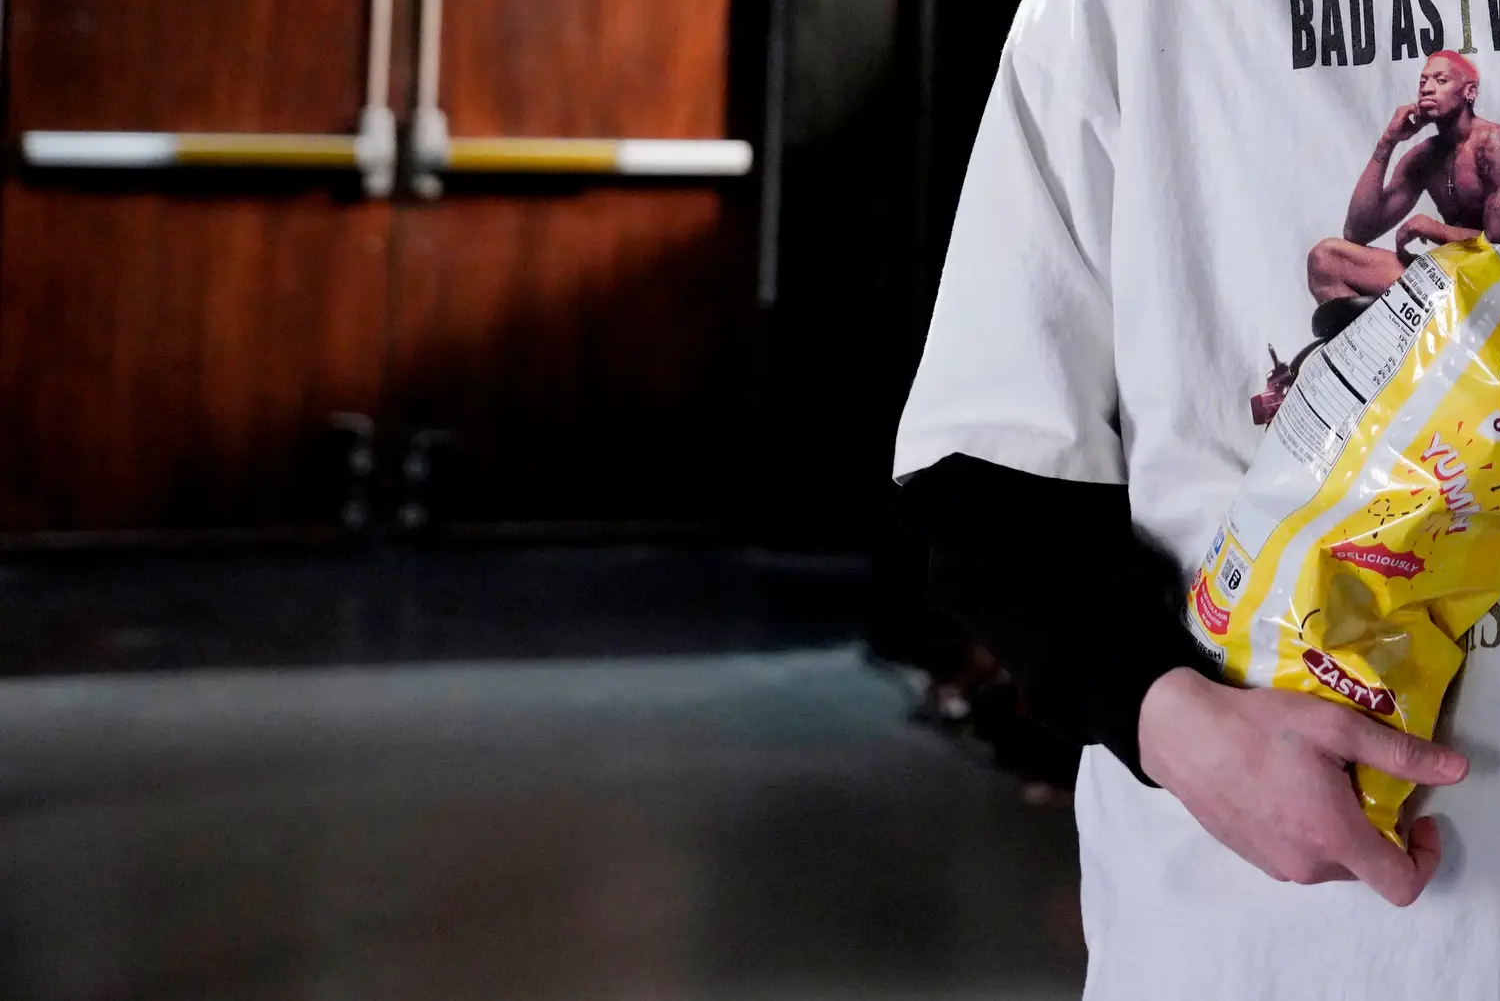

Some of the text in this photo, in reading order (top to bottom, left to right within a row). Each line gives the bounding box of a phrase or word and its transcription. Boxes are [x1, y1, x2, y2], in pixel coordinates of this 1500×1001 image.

[1426, 267, 1445, 290] Facts
[1400, 302, 1421, 327] 160
[1336, 550, 1420, 572] DELICIOUSLY
[1315, 654, 1385, 711] TASTY
